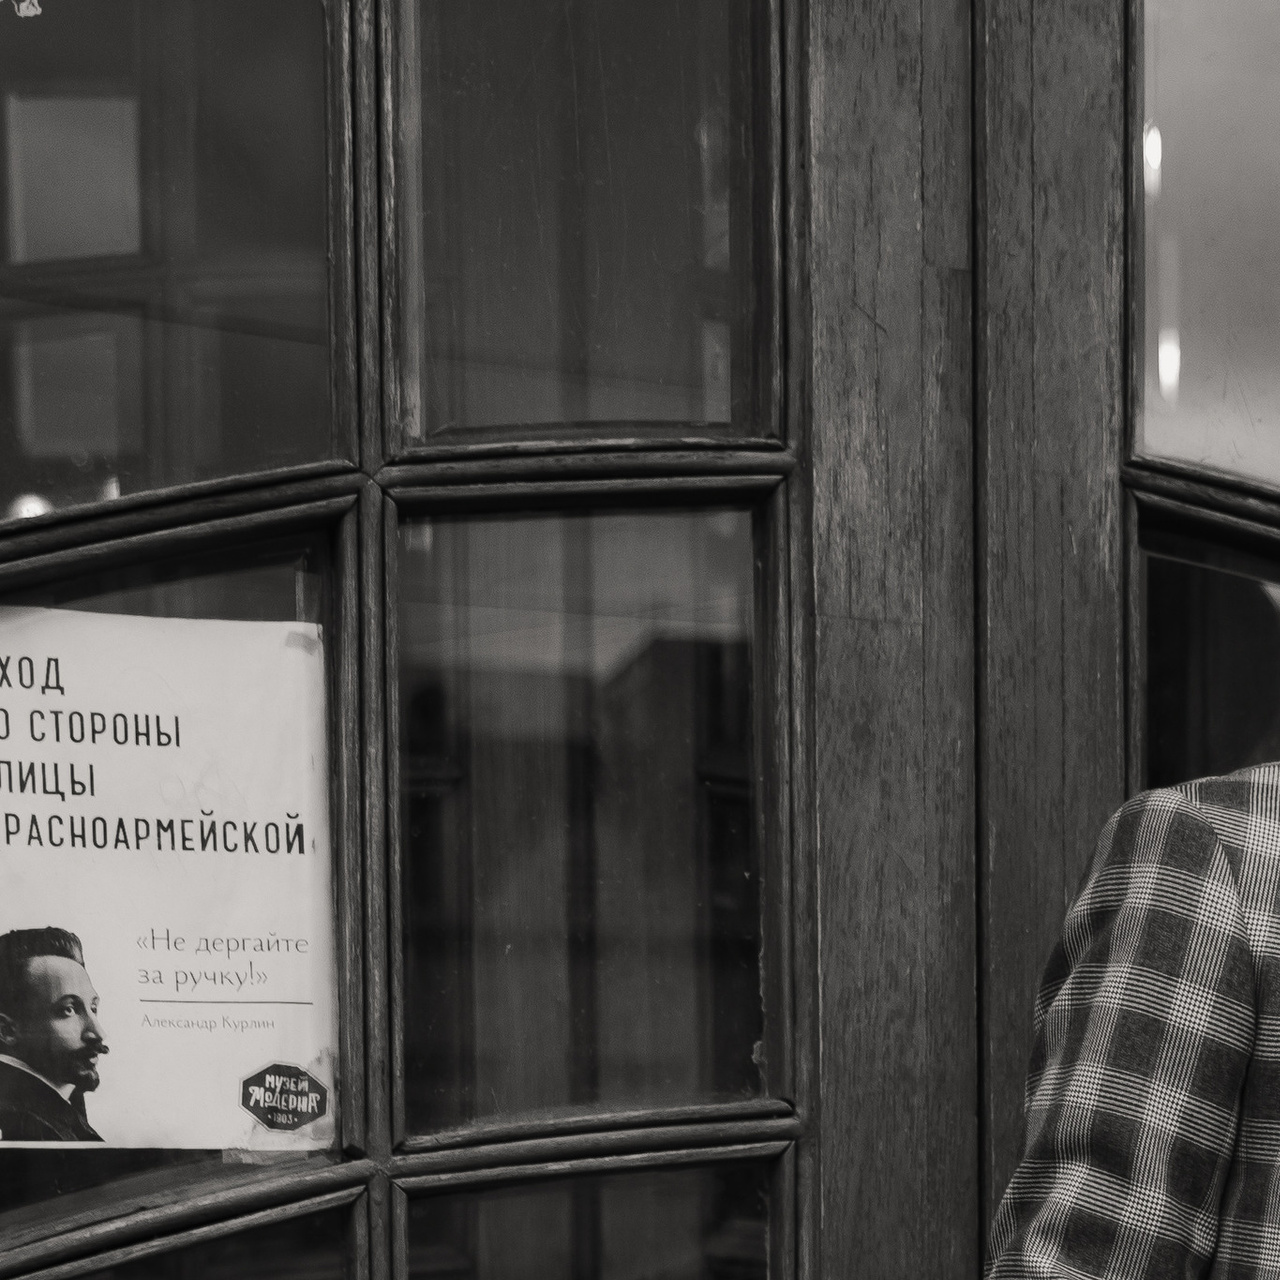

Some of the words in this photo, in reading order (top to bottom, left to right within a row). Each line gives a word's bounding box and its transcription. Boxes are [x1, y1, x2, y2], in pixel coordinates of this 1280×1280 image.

[30, 710, 180, 747] СТОРОНЫ
[195, 931, 309, 960] дергайте
[137, 967, 163, 985] за
[174, 960, 268, 992] ручку!»
[141, 1014, 217, 1032] Александр
[222, 1015, 275, 1033] Курлин
[265, 1074, 309, 1093] МУЗЕЙ
